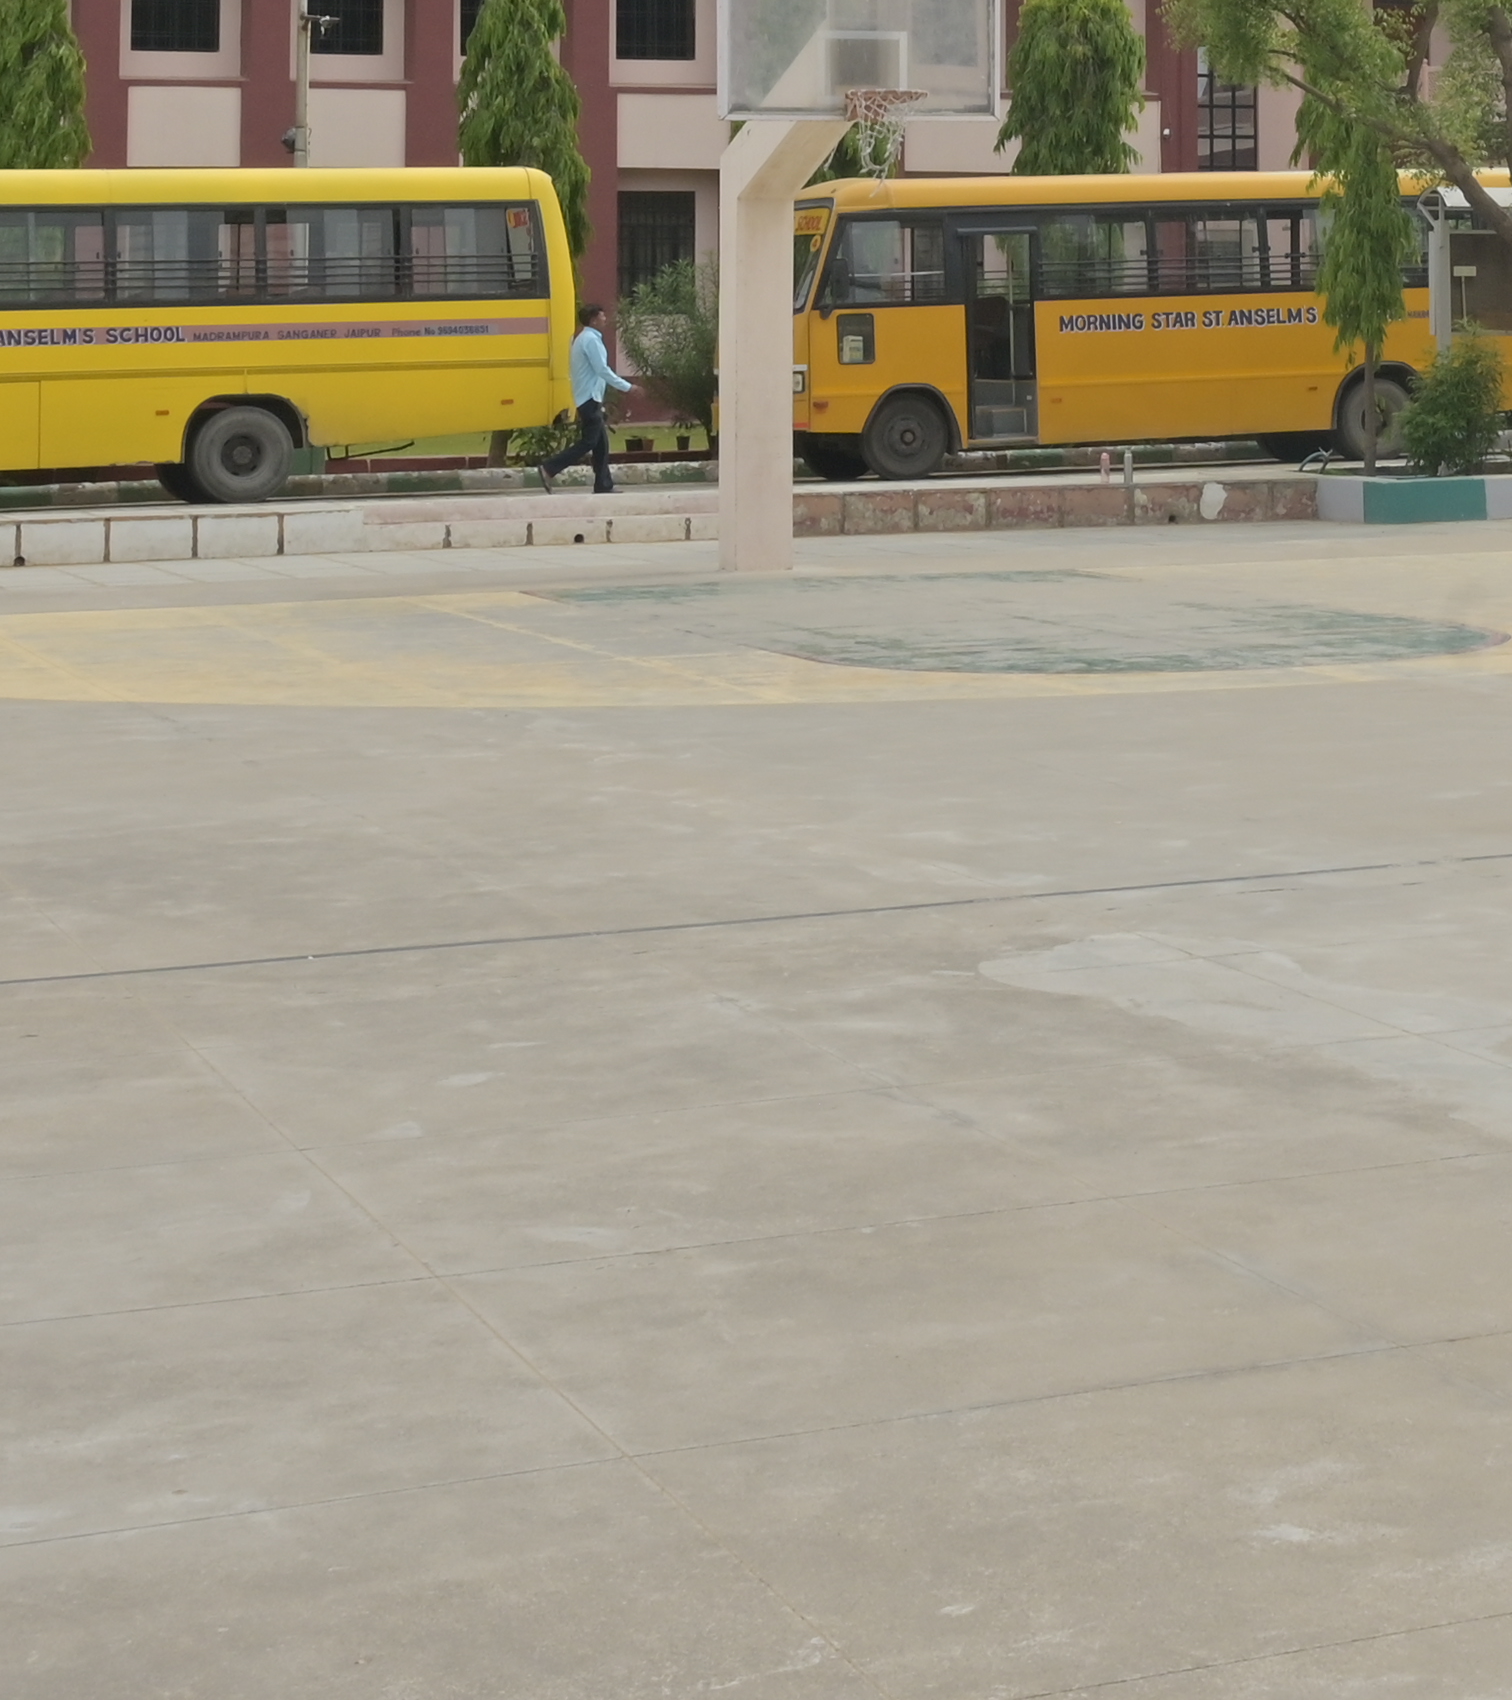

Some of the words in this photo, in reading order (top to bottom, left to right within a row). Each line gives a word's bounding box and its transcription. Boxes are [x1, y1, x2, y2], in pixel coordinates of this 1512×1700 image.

[1059, 313, 1145, 333] MORNING
[1151, 311, 1197, 330] STAR
[1228, 306, 1318, 327] ANSELM'S
[105, 326, 186, 344] SCHOOL
[193, 331, 269, 342] MADRAMPURA
[344, 328, 381, 338] JAIPUR
